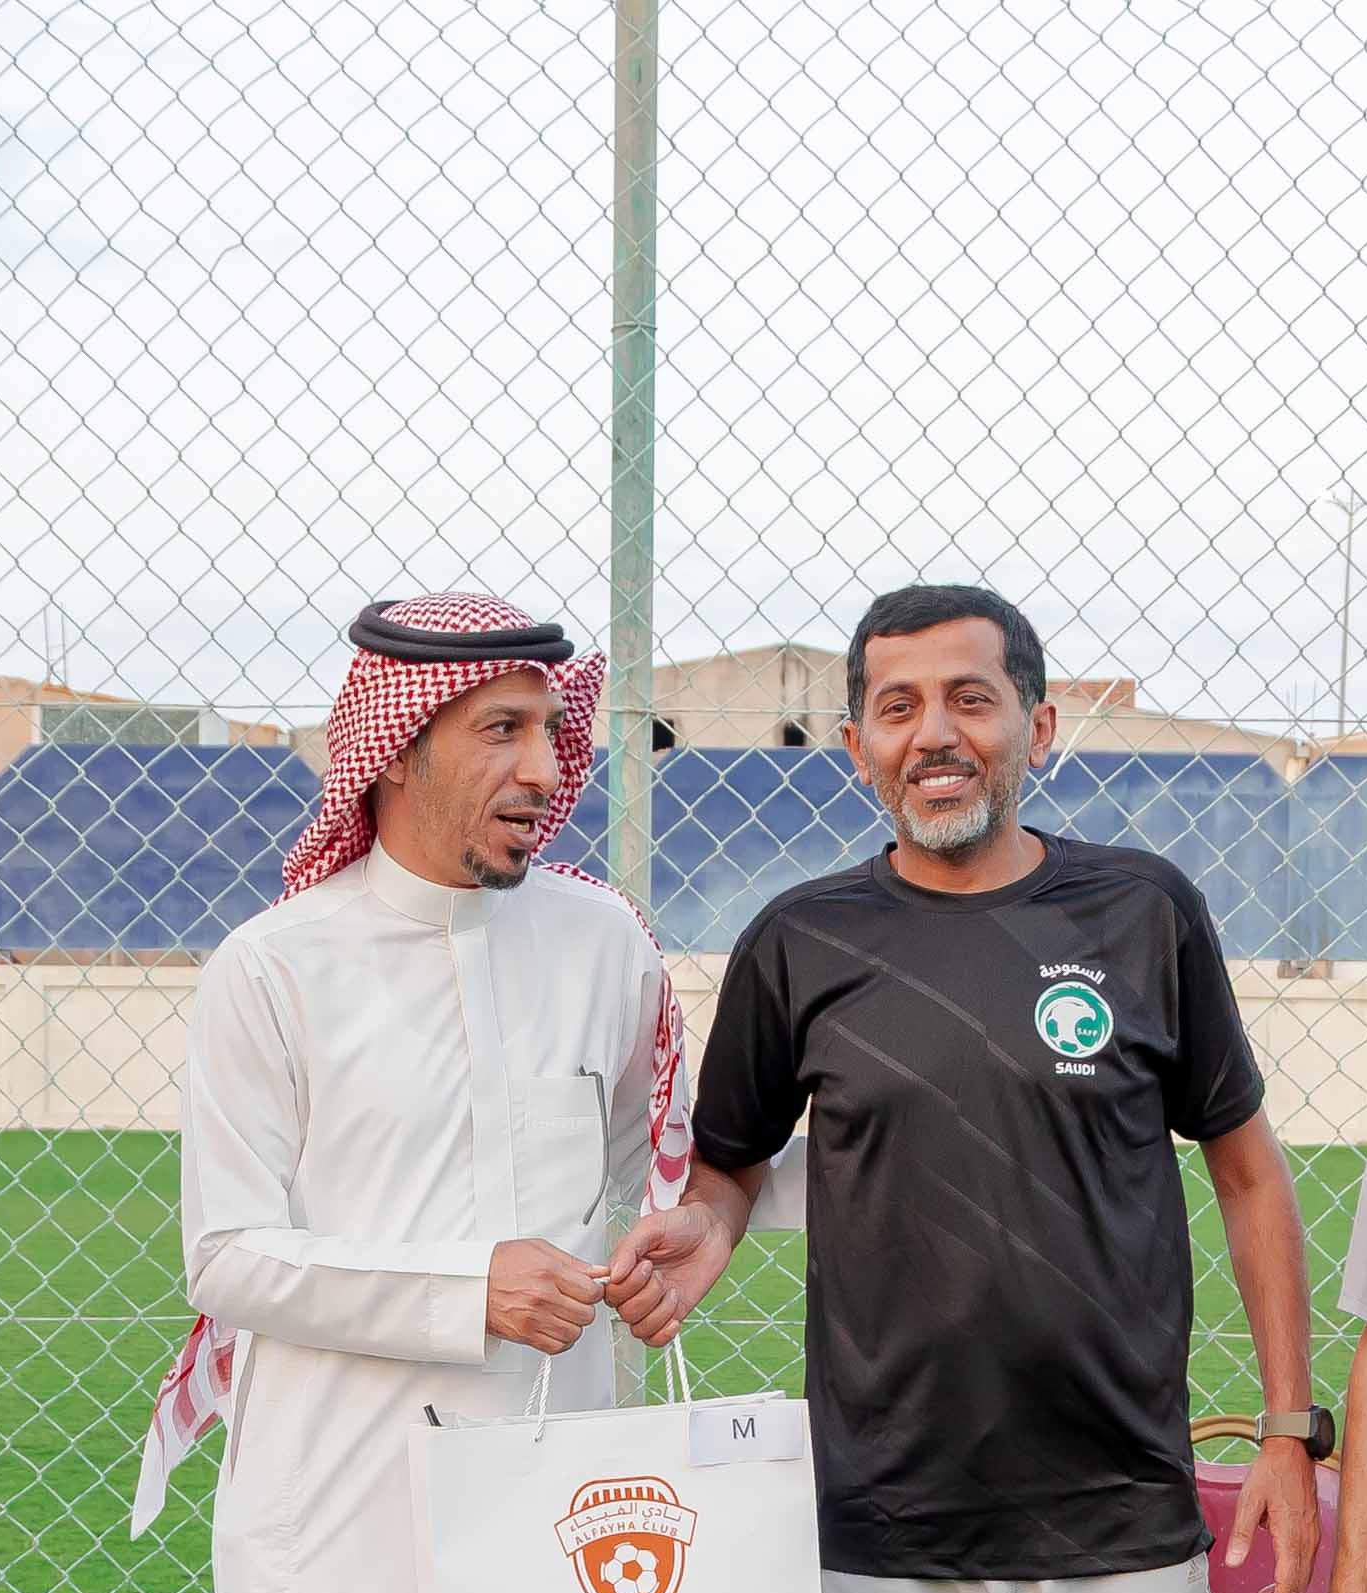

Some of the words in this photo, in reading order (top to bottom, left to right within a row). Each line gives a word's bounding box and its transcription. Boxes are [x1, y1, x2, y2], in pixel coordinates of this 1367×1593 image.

[1039, 963, 1106, 985] السعودية
[1055, 1061, 1096, 1076] SAUDI
[732, 1417, 756, 1439] M
[574, 1520, 637, 1546] ALFAYHA
[642, 1521, 679, 1538] CLUB
